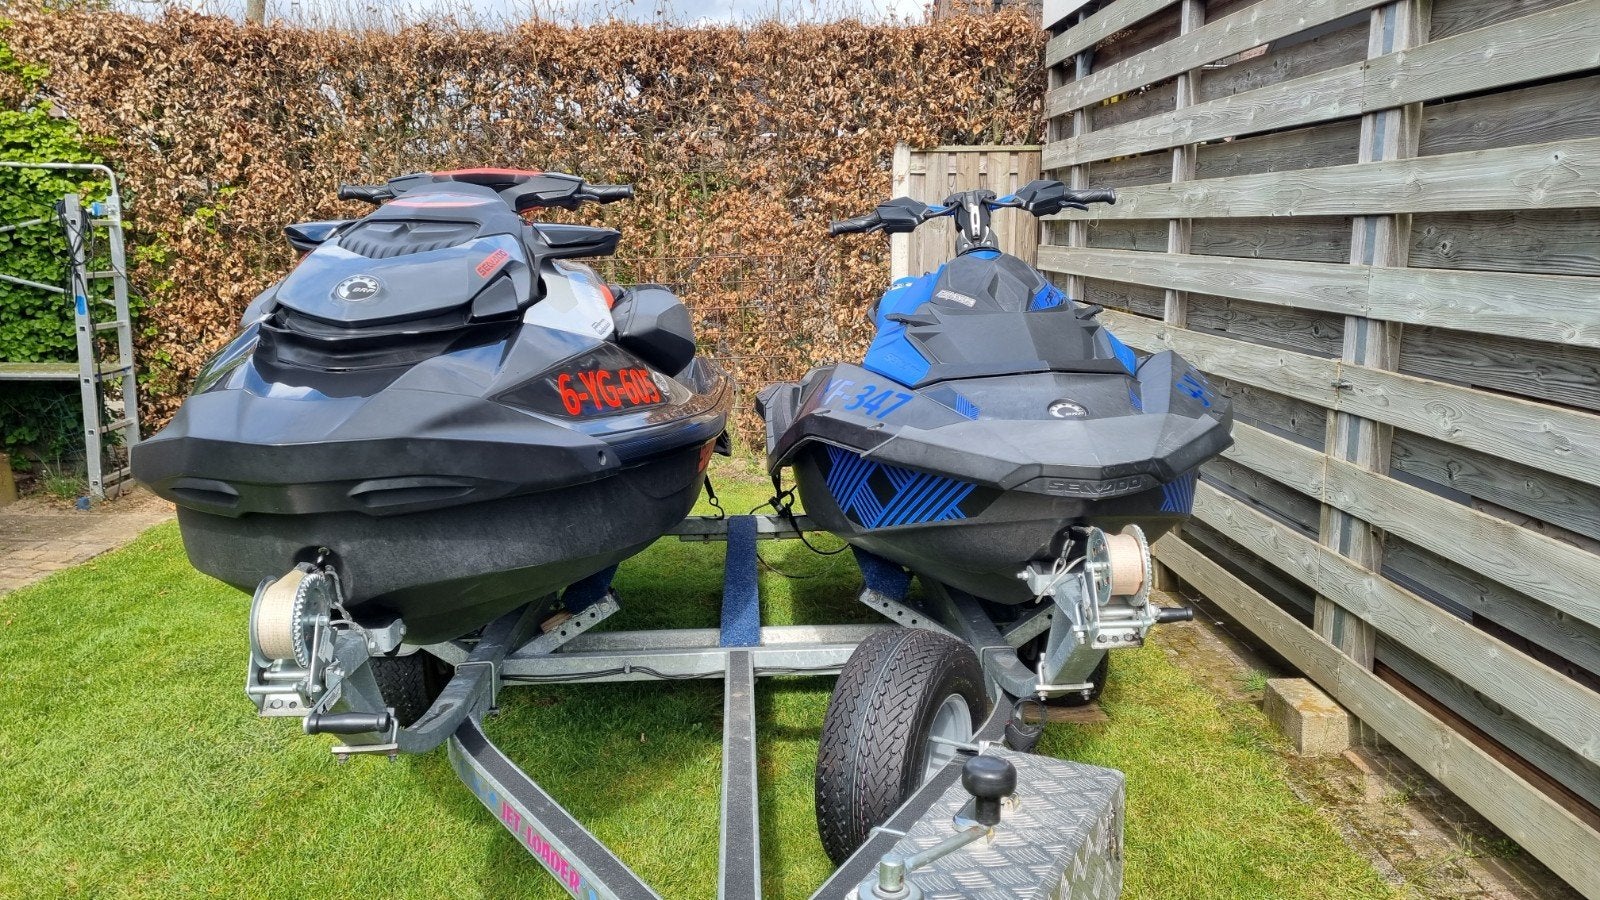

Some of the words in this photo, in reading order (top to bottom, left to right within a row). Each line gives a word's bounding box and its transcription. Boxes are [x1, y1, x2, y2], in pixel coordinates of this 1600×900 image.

[558, 368, 660, 415] 6-YG-605
[501, 801, 521, 832] JET
[525, 826, 581, 894] LOADER
